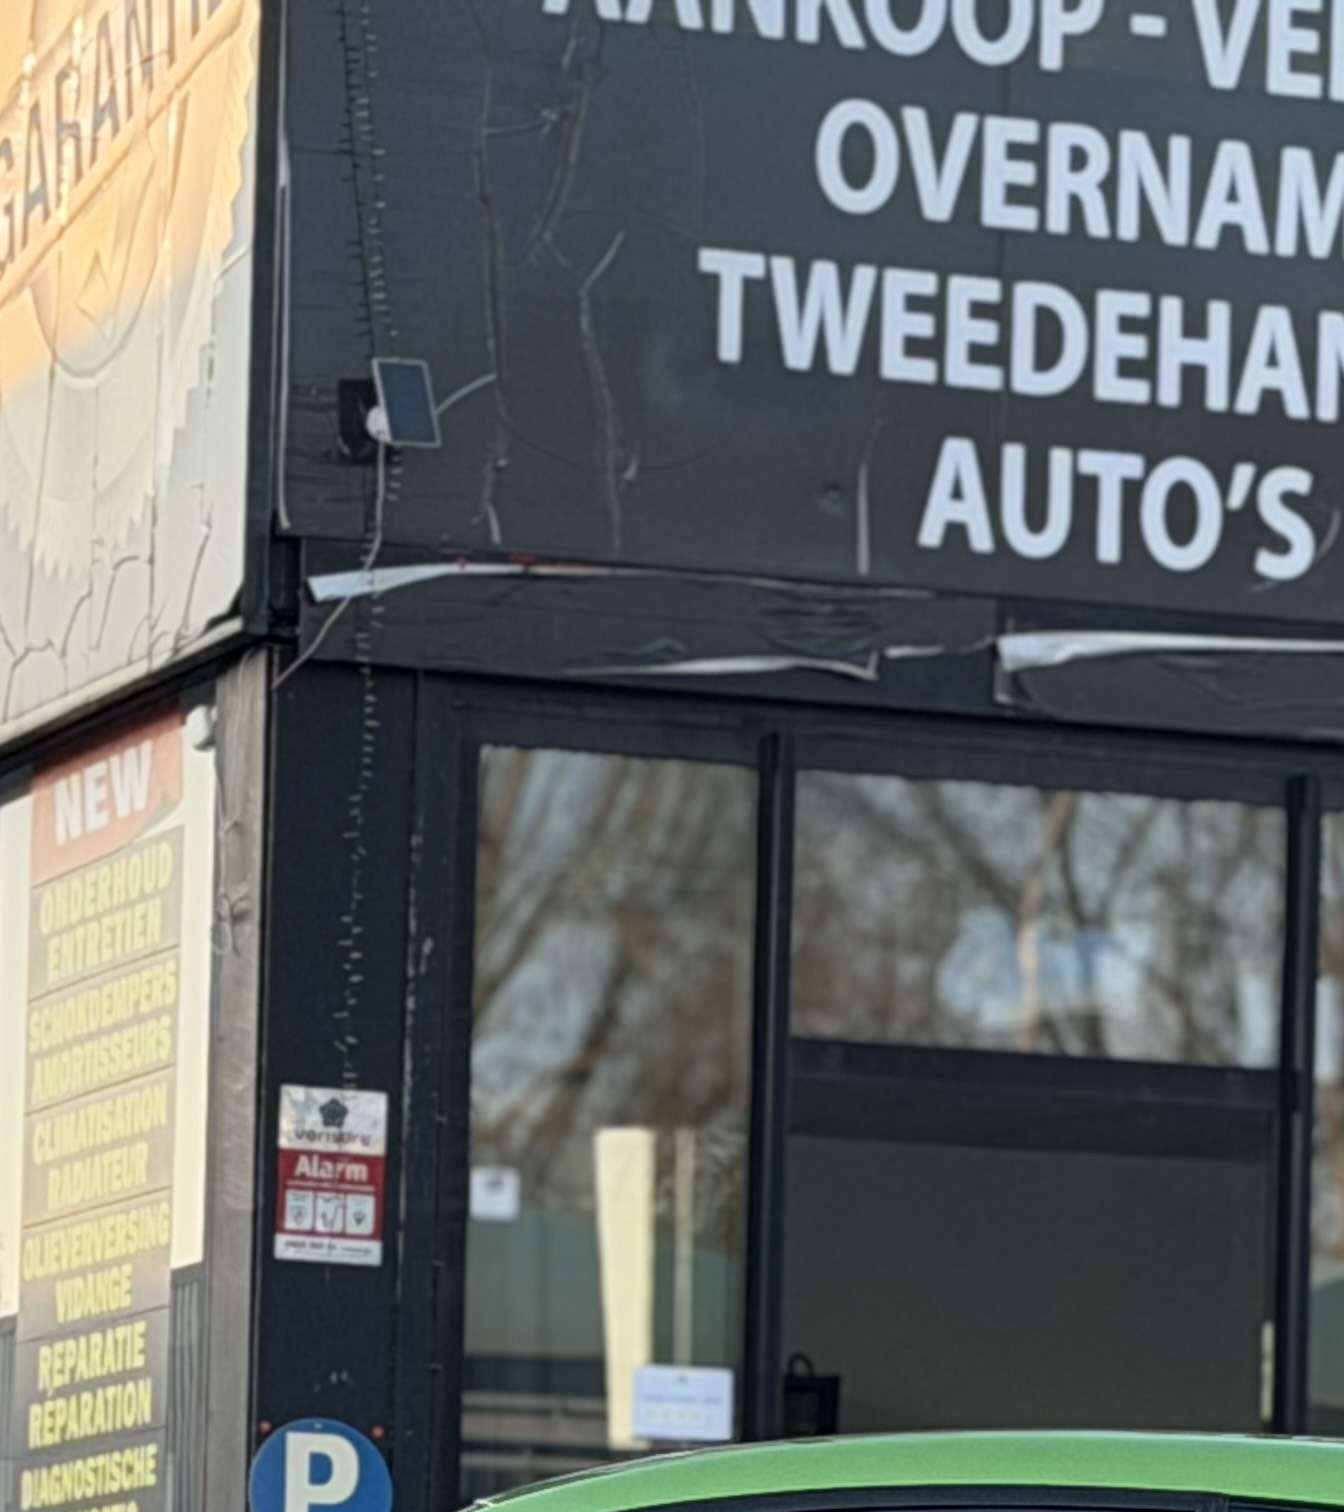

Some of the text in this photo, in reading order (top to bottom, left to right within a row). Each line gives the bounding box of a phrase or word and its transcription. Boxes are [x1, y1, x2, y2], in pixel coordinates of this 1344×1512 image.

[916, 436, 1317, 582] AUTO'S
[53, 738, 154, 848] NEW
[40, 841, 174, 937] ONDERHOUD
[45, 896, 163, 987] ENTRETIEN
[28, 957, 178, 1055] SCHOKDEMPERS
[30, 1013, 172, 1106] AMORTISSEURS
[32, 1080, 168, 1166] CLIMATISATION
[47, 1140, 149, 1211] RADIATEUR
[293, 1152, 370, 1183] Alarm
[21, 1199, 171, 1281] OLIEVERVERSING
[54, 1263, 134, 1325] VIDANGE
[37, 1319, 148, 1391] REPARATIE
[20, 1442, 159, 1512] DIAGNOSTISCHE
